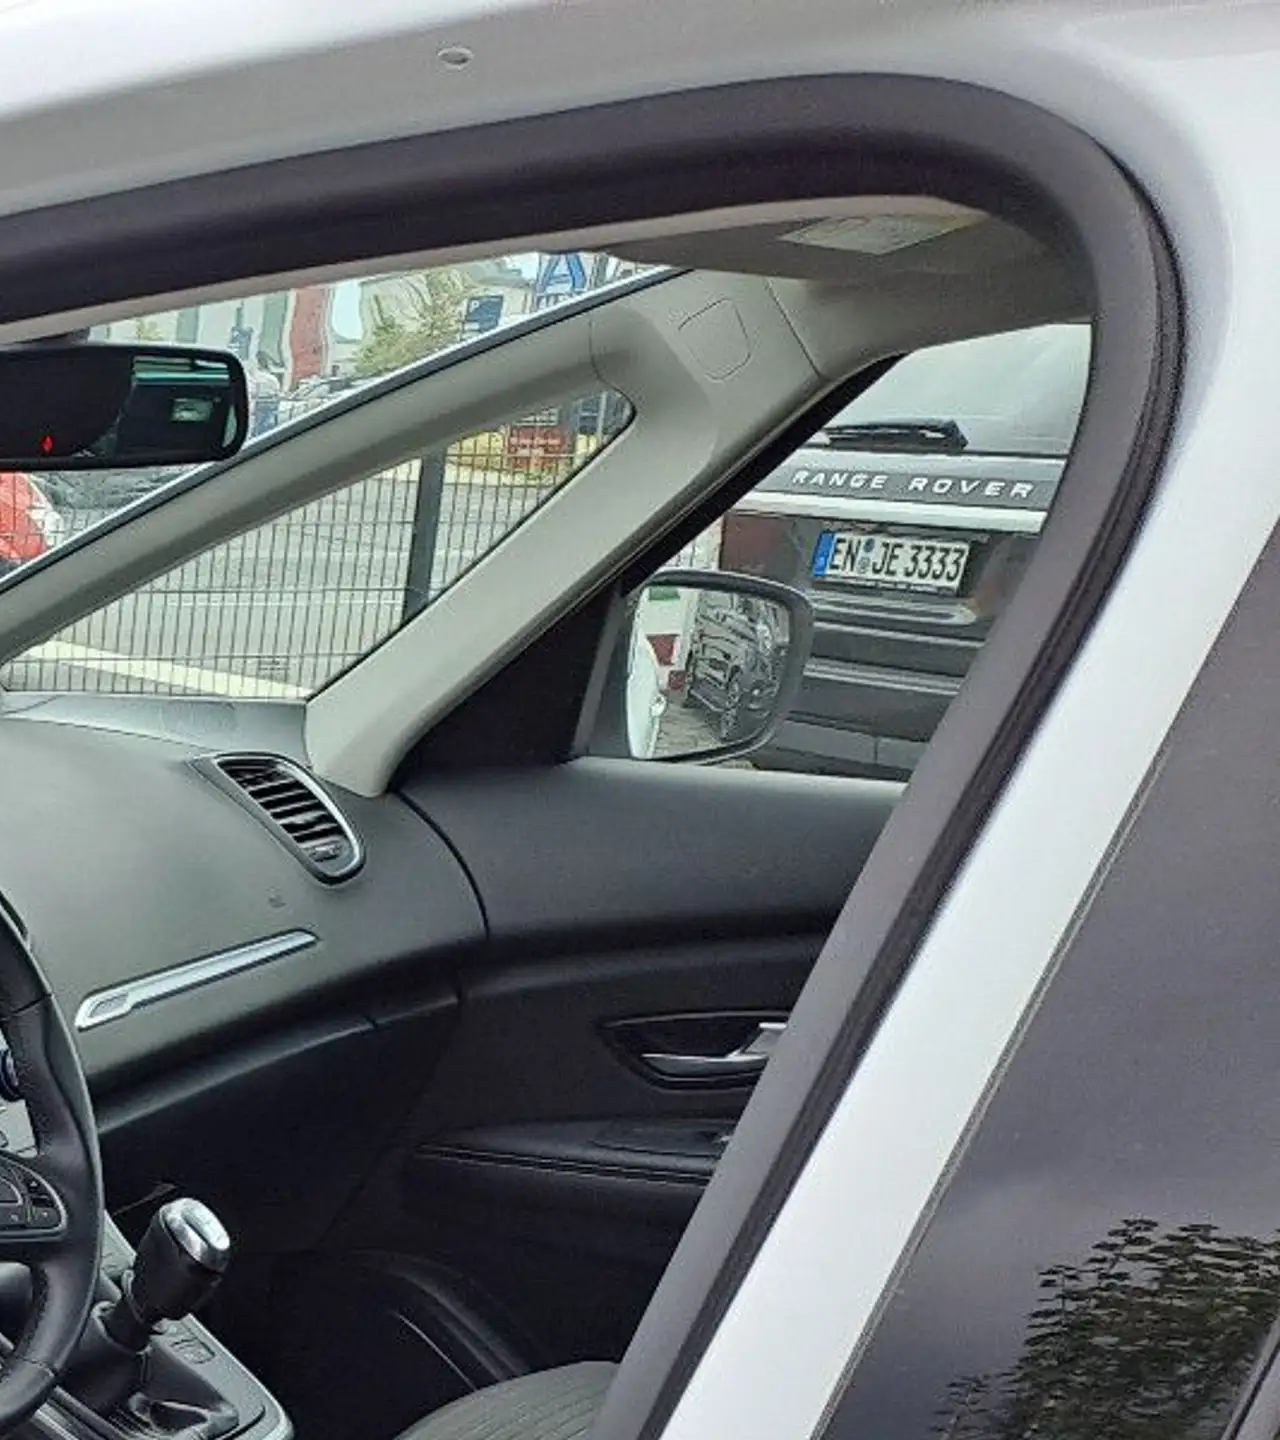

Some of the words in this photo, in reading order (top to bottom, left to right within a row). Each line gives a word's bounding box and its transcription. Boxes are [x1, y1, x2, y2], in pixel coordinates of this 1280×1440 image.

[792, 470, 889, 490] RANGE
[907, 476, 1035, 499] ROVER
[829, 537, 861, 573] EN
[871, 541, 904, 577] JE
[904, 544, 966, 582] 3333
